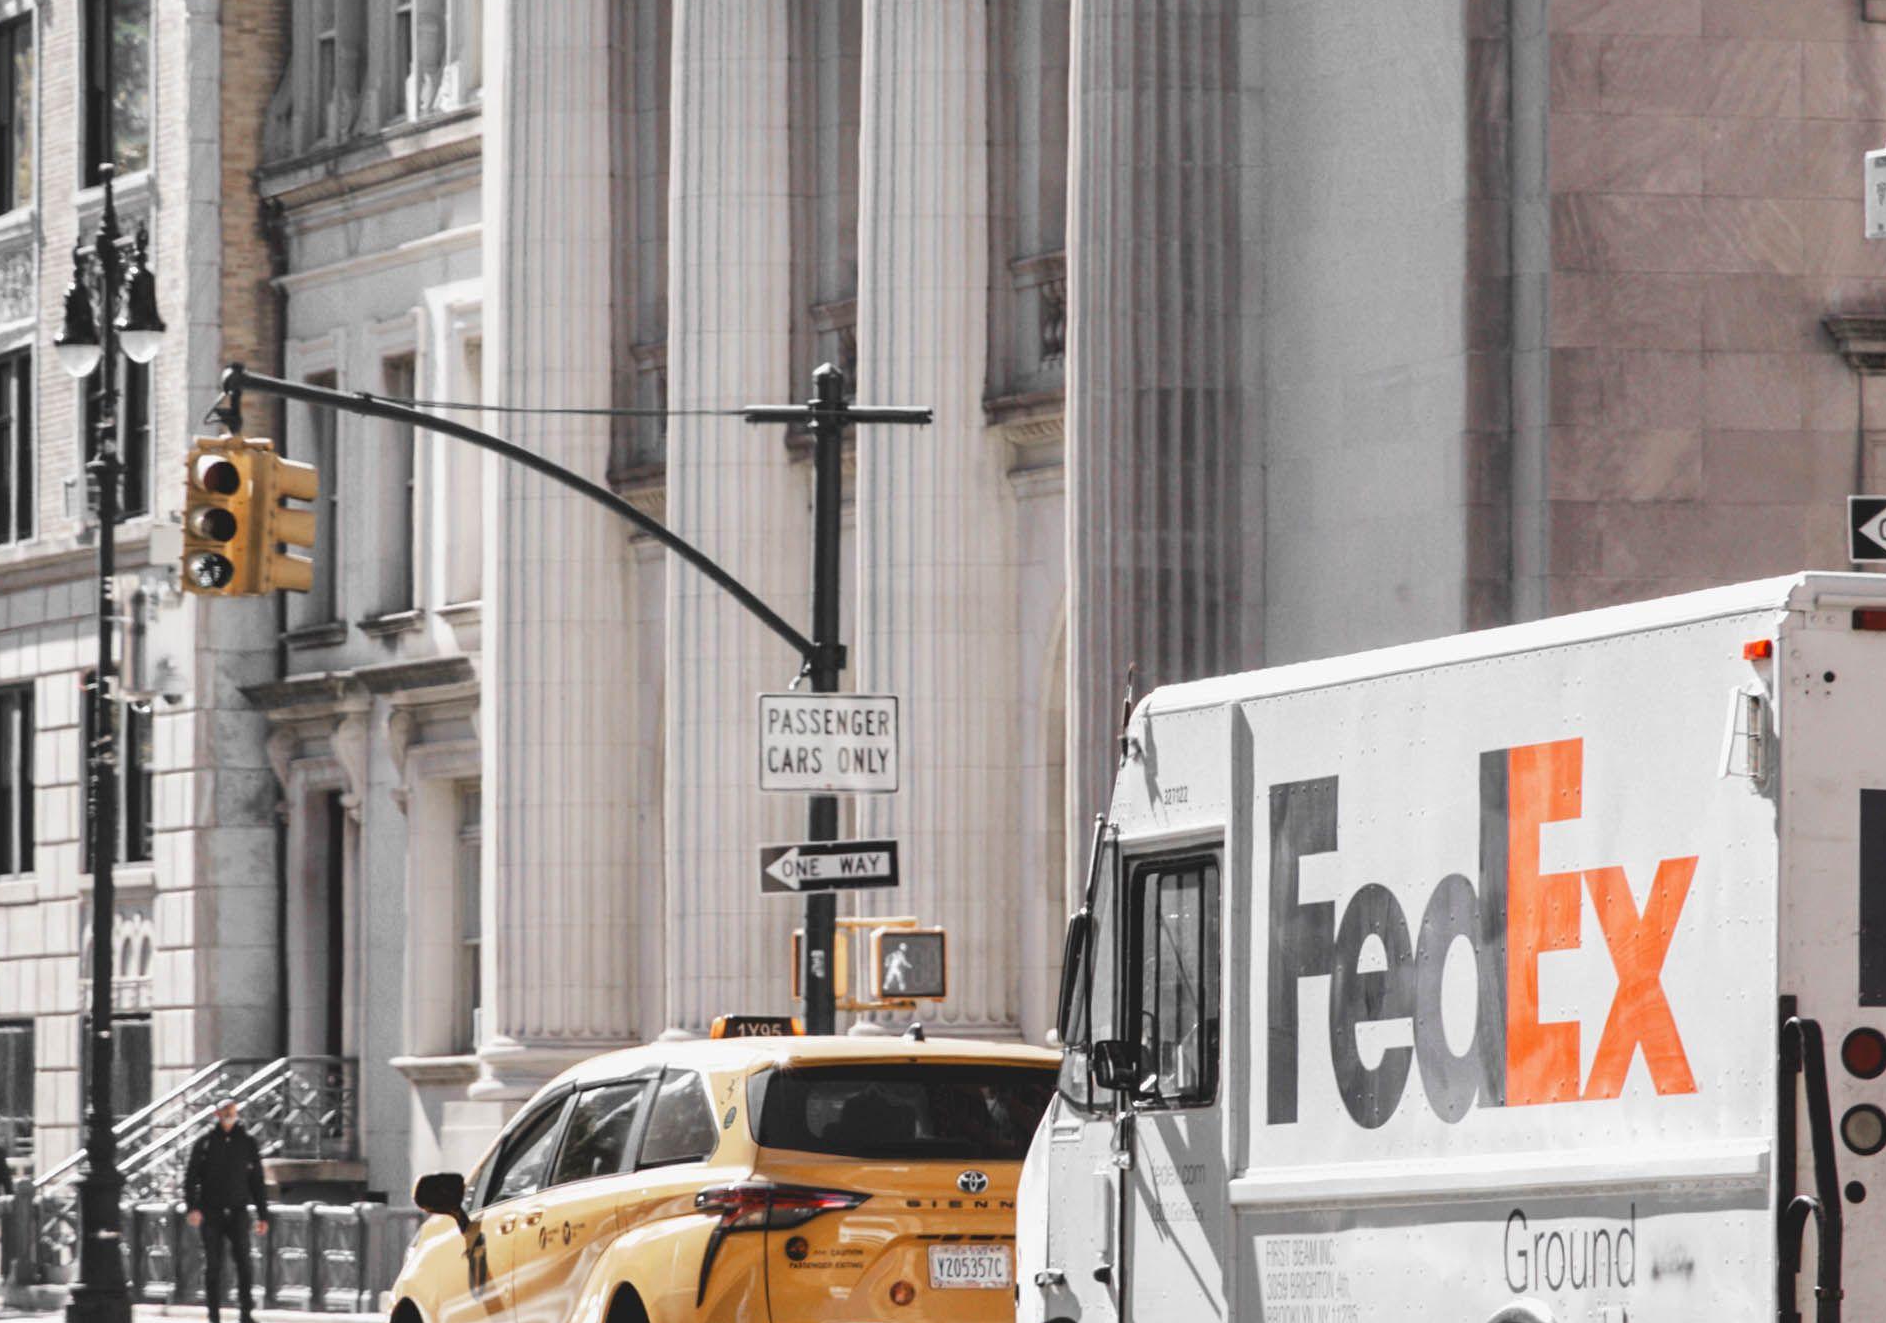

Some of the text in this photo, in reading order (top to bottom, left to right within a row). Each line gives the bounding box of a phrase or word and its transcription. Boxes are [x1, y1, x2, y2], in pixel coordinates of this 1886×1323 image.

[767, 708, 890, 737] PASSENGER
[767, 747, 889, 775] CARS ONLY
[781, 855, 880, 877] ONE WAY
[1266, 736, 1699, 1130] FedEx
[1266, 1239, 1291, 1267] FIRST
[1504, 1202, 1636, 1294] Ground
[936, 1256, 1003, 1278] Y205357C
[1290, 1271, 1334, 1300] BRIGHTON
